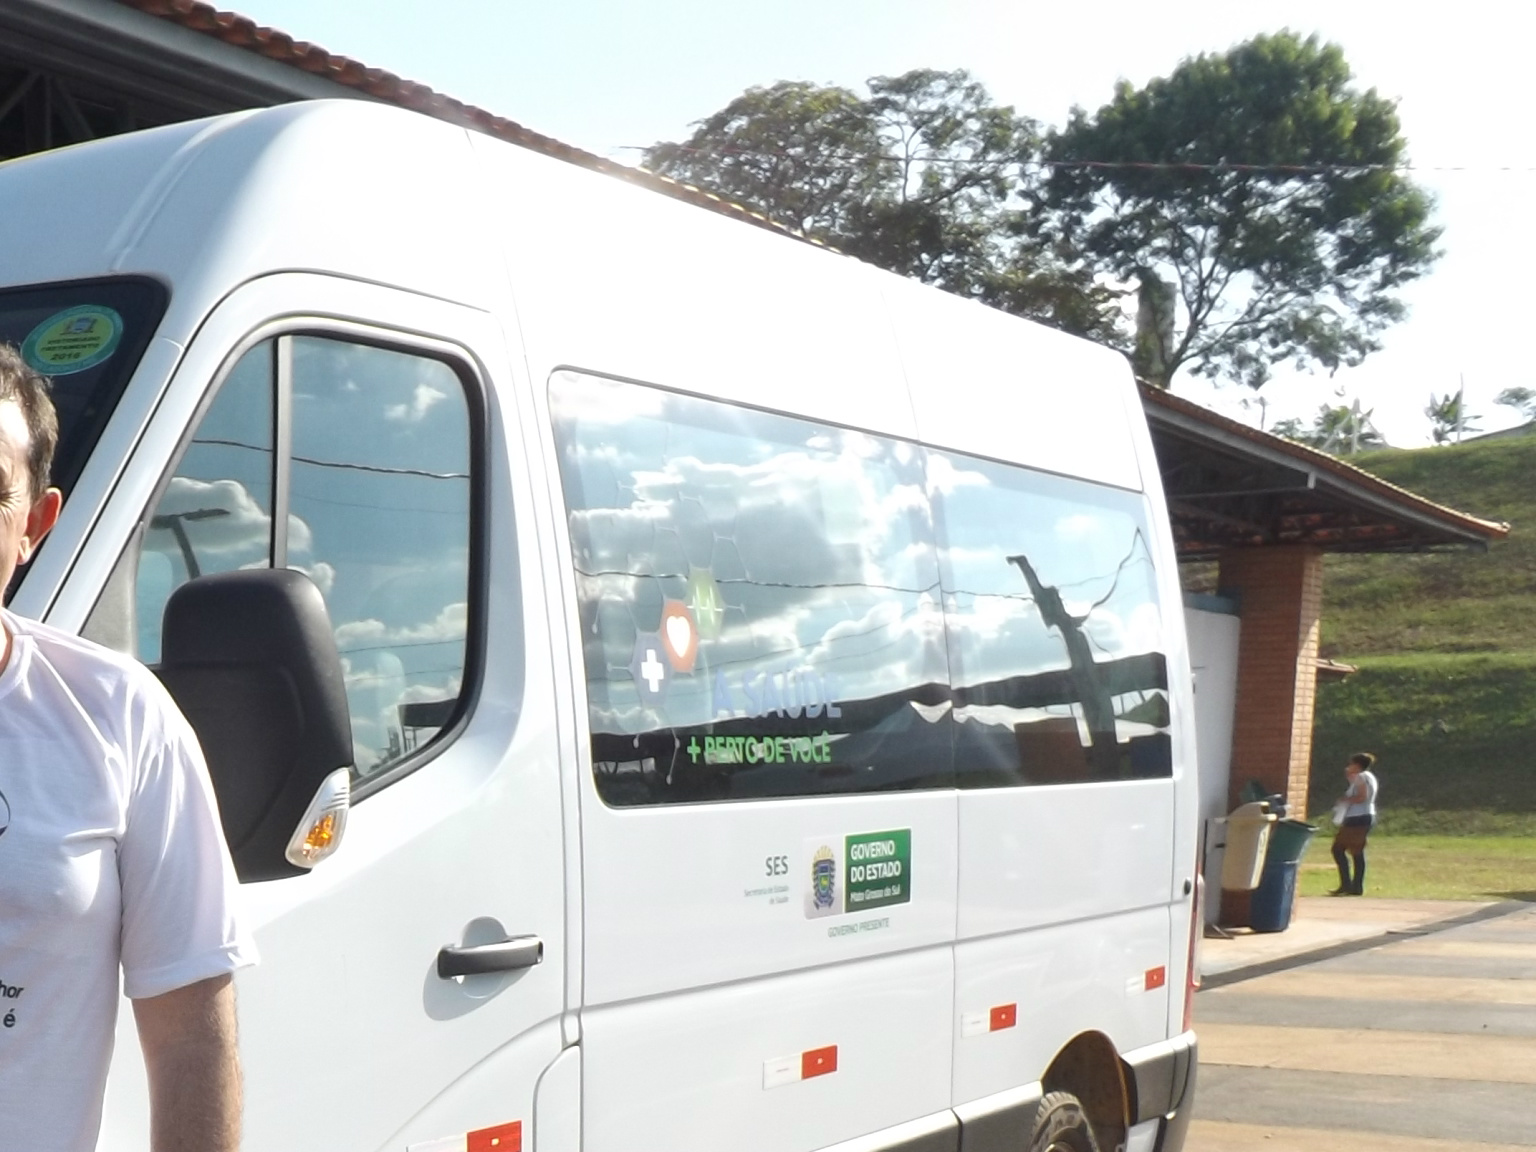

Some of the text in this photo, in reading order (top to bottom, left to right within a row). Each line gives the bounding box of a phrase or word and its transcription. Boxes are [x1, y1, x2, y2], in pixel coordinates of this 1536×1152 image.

[50, 352, 82, 361] 2016
[704, 735, 759, 765] PERTO
[763, 736, 786, 764] DE
[790, 730, 832, 764] VOCÊ
[850, 840, 896, 861] GOVERNO
[765, 855, 789, 877] SES
[850, 861, 902, 883] DO ESTADO
[3, 1007, 16, 1028] é
